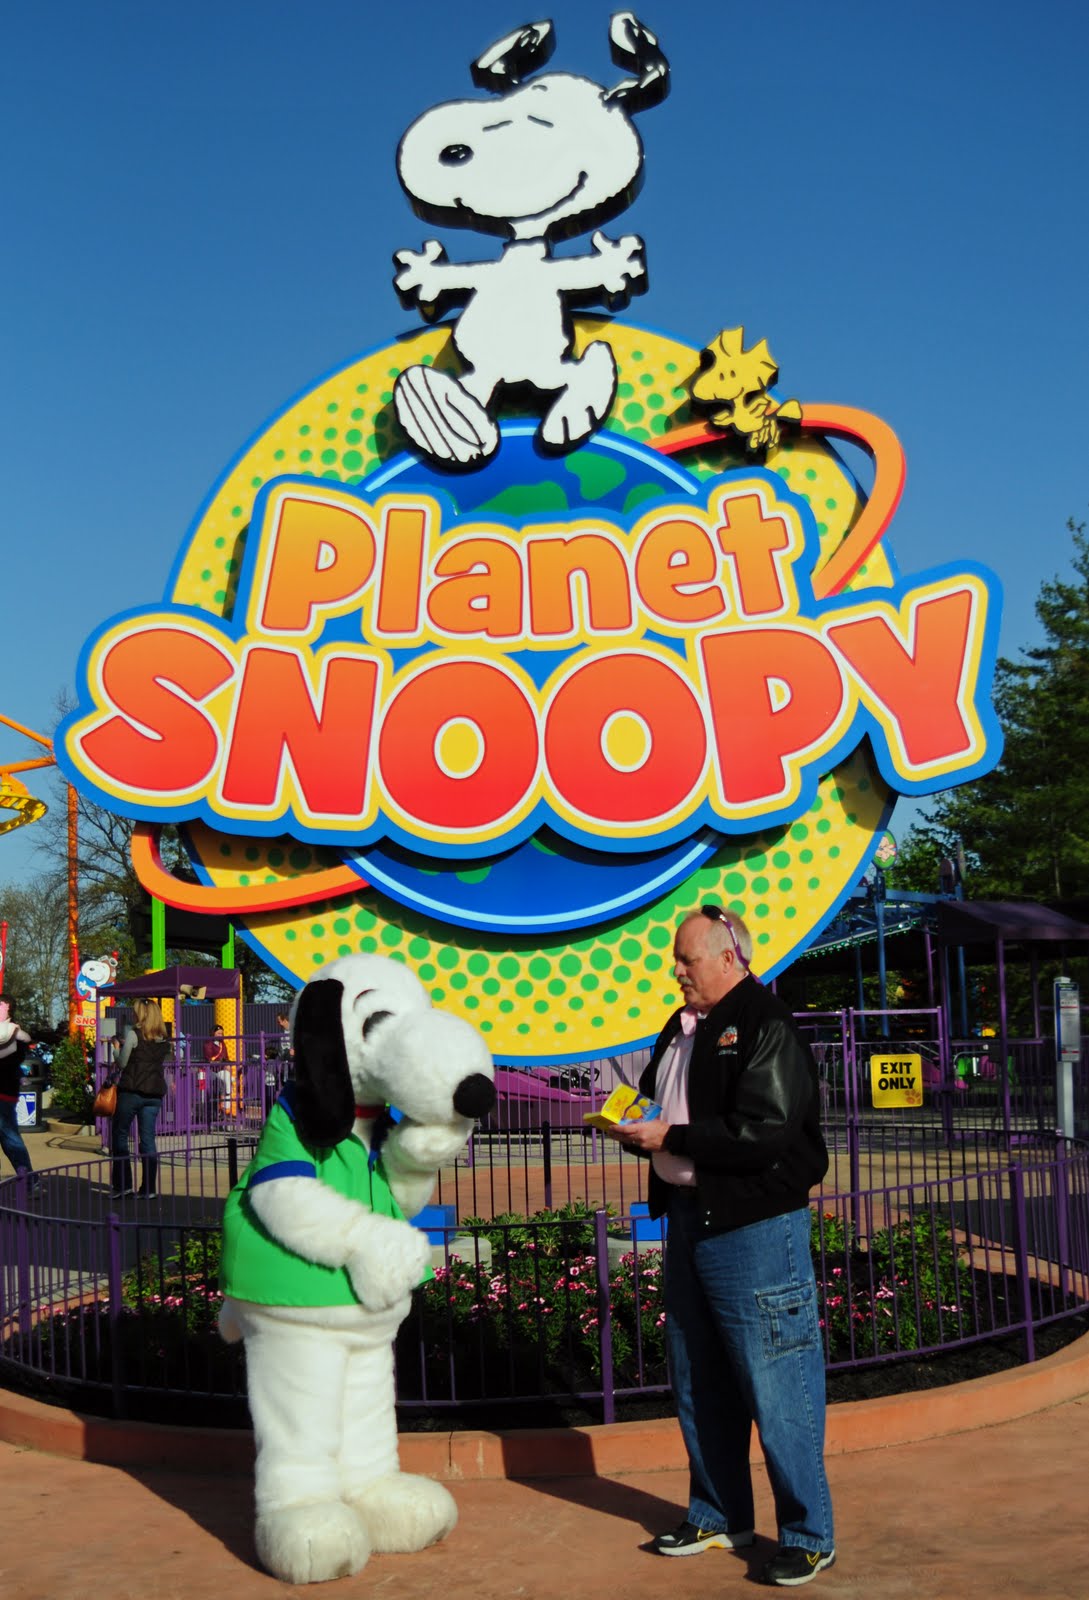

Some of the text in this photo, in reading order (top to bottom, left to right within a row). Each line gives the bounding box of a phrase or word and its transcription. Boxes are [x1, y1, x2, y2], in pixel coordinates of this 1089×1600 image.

[259, 486, 795, 638] Planet
[78, 587, 978, 829] SNOOPY
[878, 1077, 915, 1091] ONLY
[880, 1061, 912, 1075] EXIT
